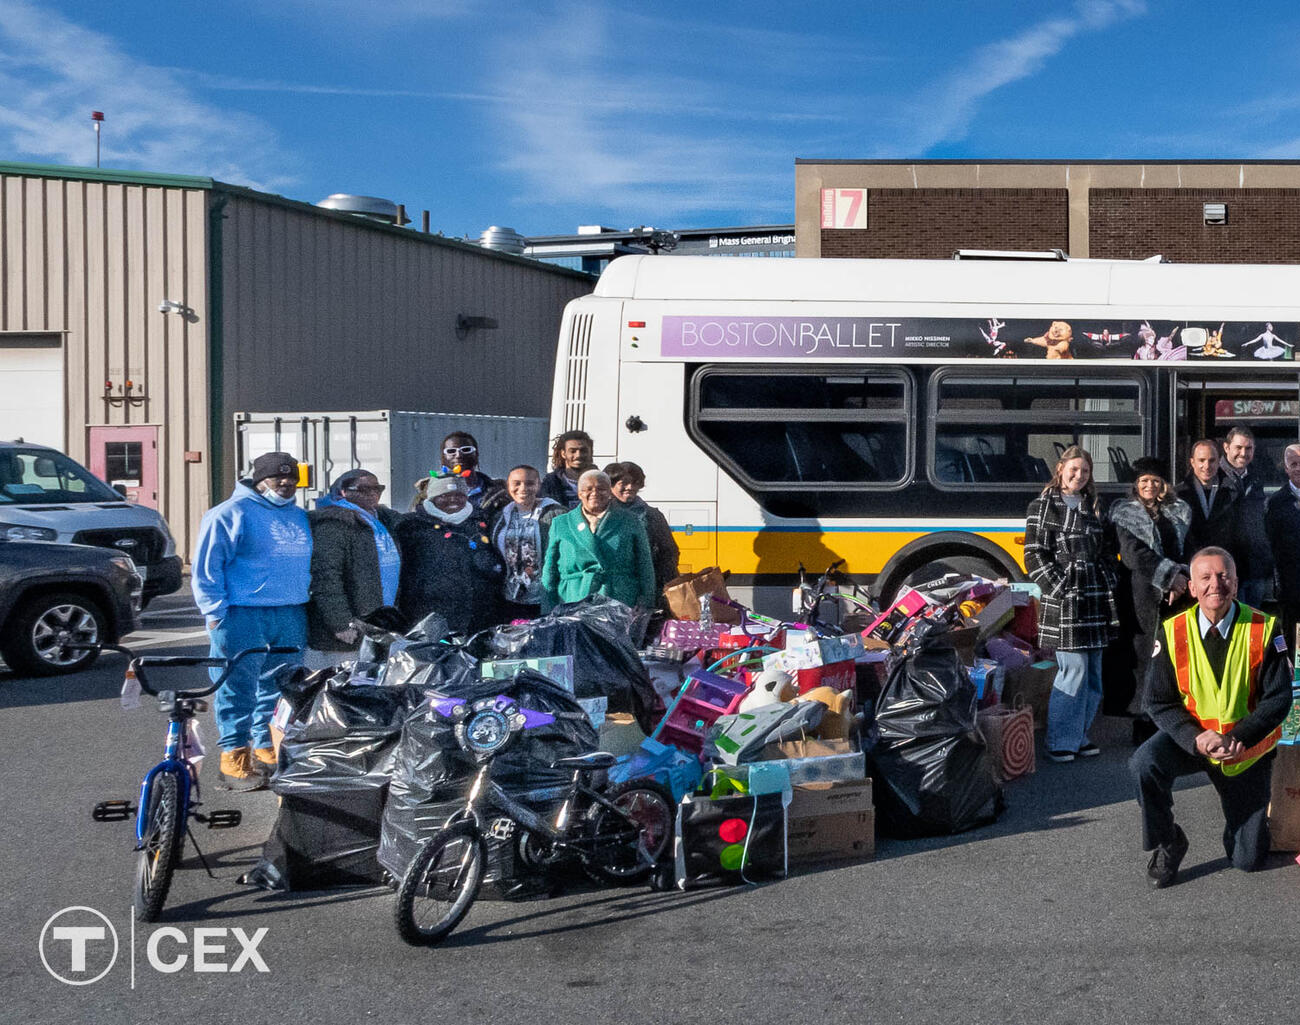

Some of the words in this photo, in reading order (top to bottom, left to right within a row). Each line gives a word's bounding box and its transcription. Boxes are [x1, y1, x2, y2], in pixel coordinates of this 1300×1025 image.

[841, 190, 863, 228] 7
[719, 238, 739, 246] Mass
[740, 235, 771, 245] General
